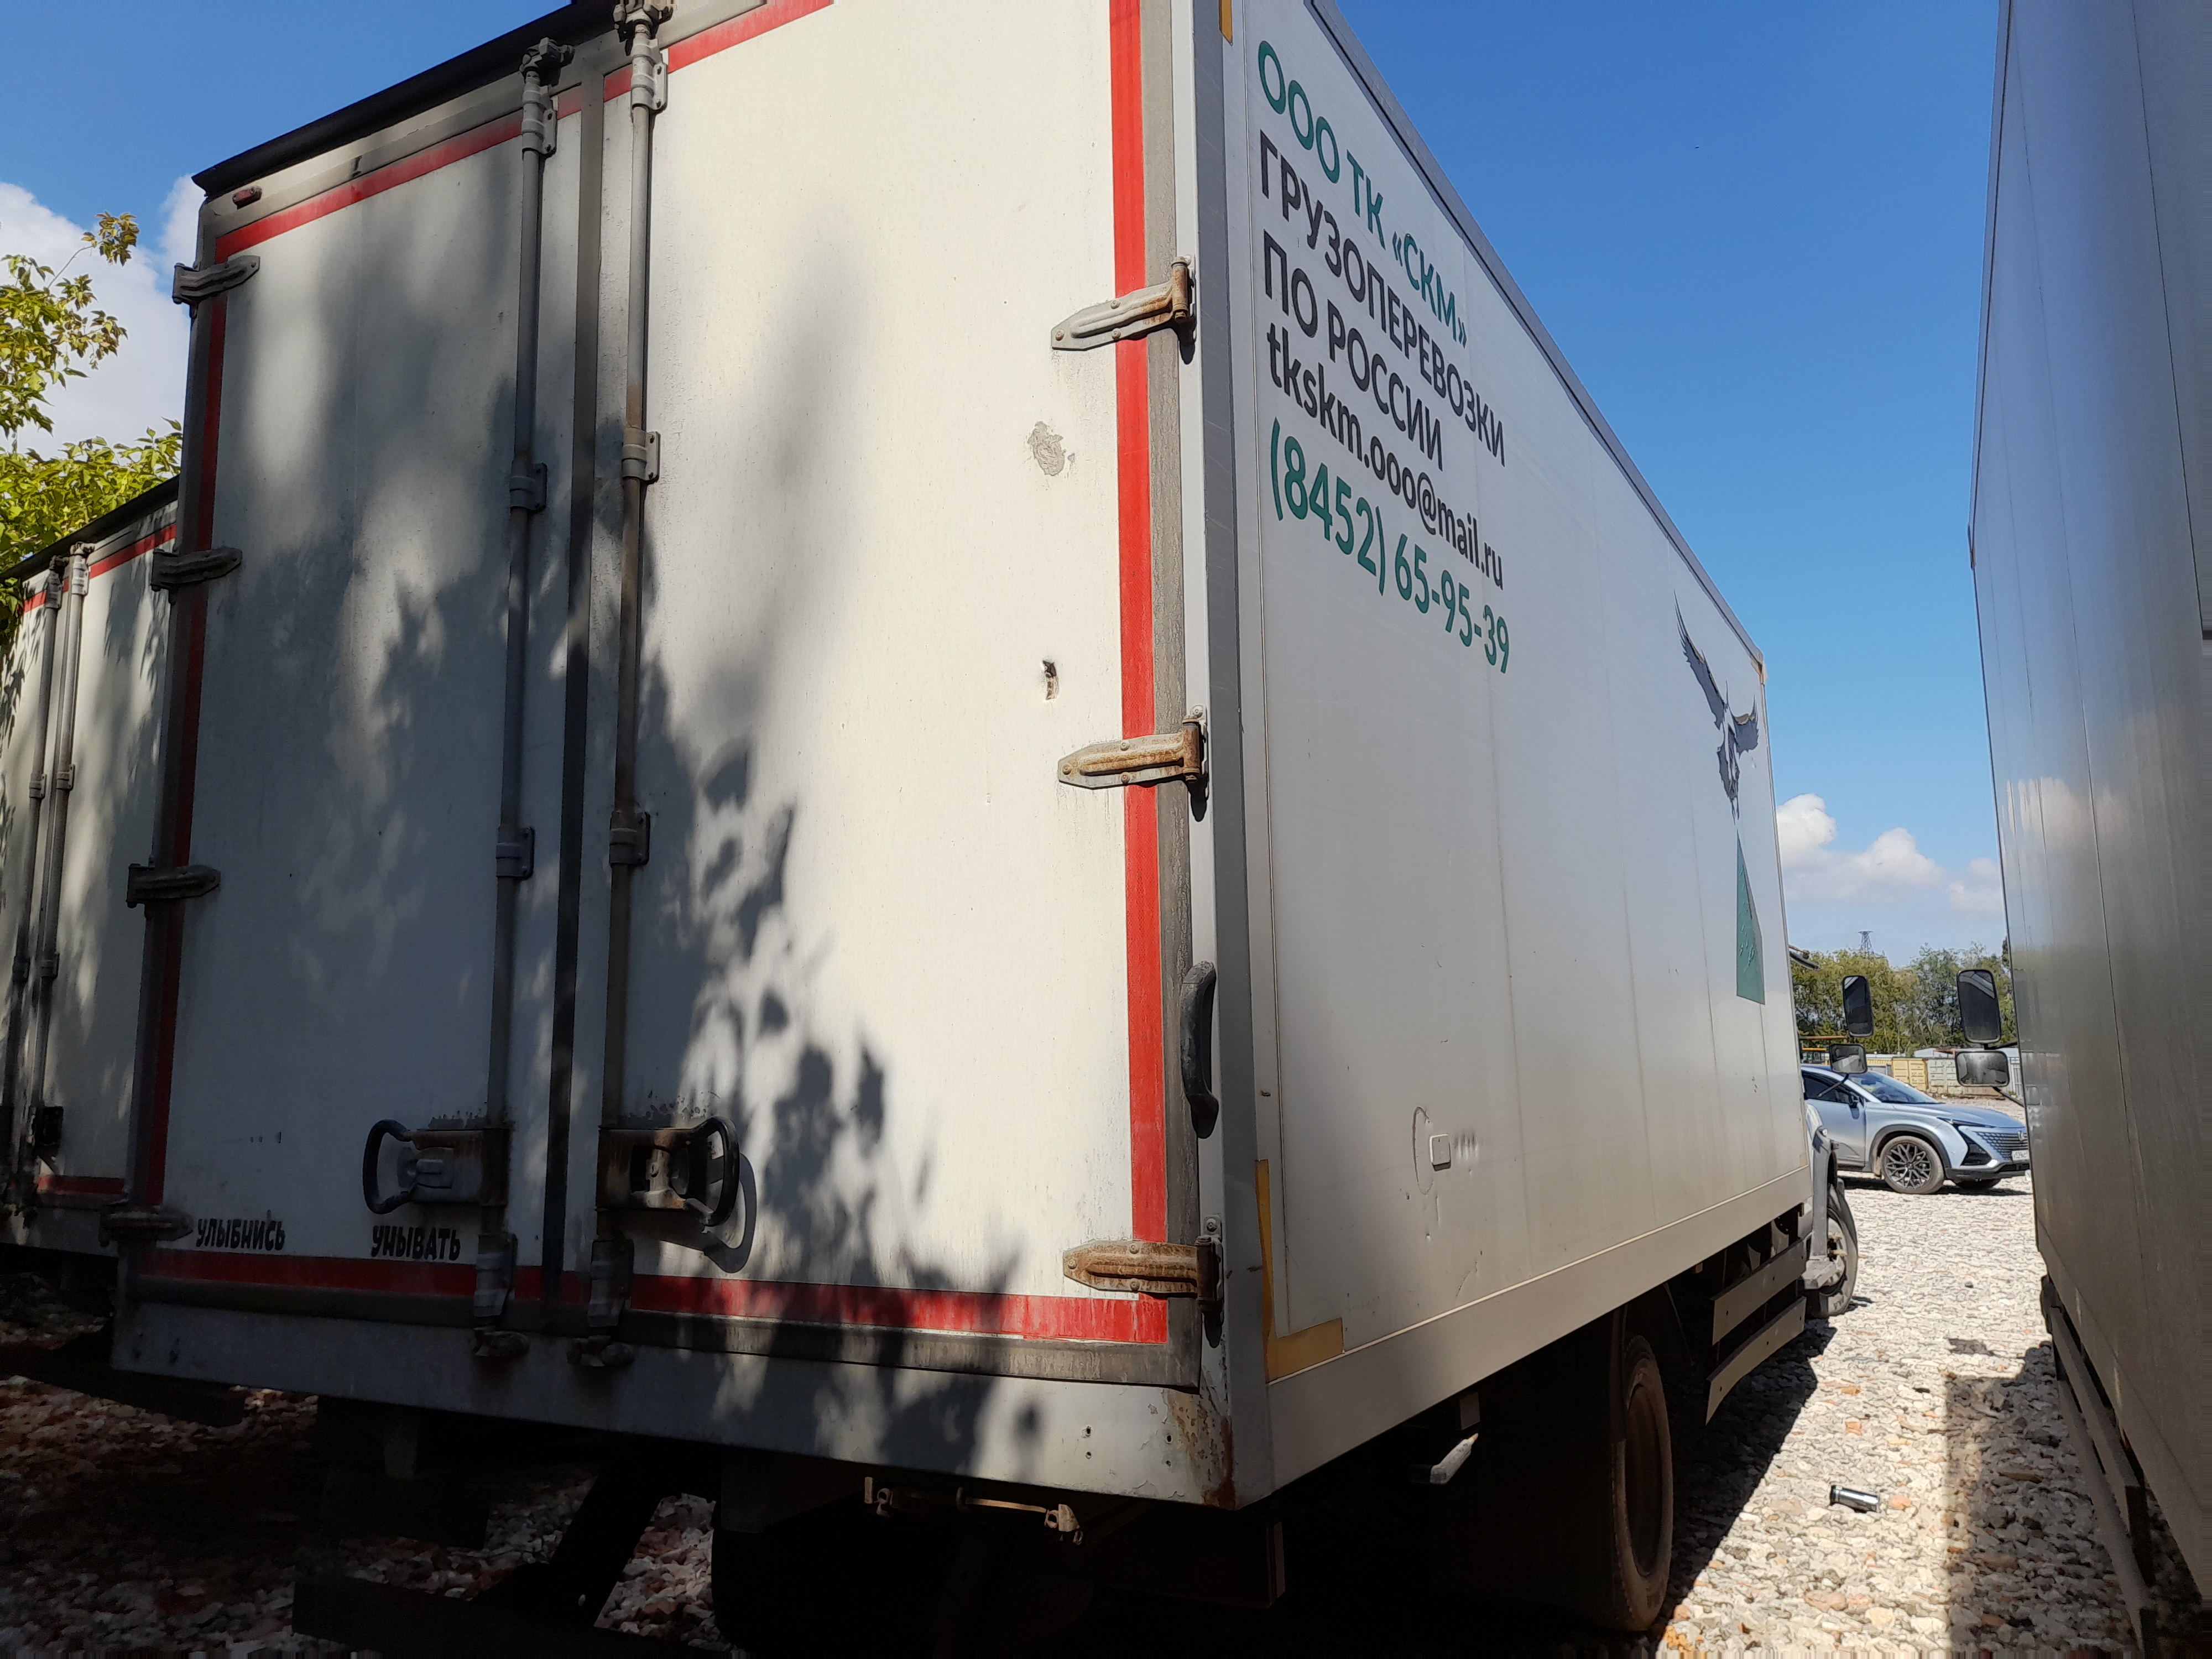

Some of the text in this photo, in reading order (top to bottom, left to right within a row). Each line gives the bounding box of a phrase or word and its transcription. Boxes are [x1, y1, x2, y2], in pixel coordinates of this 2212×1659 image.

[1258, 40, 1467, 348] ООО ТК «СКМ»
[1260, 129, 1505, 467] ГРУЗОПЕРЕВОЗКИ
[1264, 229, 1442, 472] ПО РОССИИ
[1267, 322, 1503, 590] tkskm.ooo@mail.ru
[1271, 416, 1509, 674] (8452) 65-95-39
[196, 1218, 285, 1251] УЛЫБНИСЬ
[371, 1225, 461, 1261] УНЫВАТЬ
